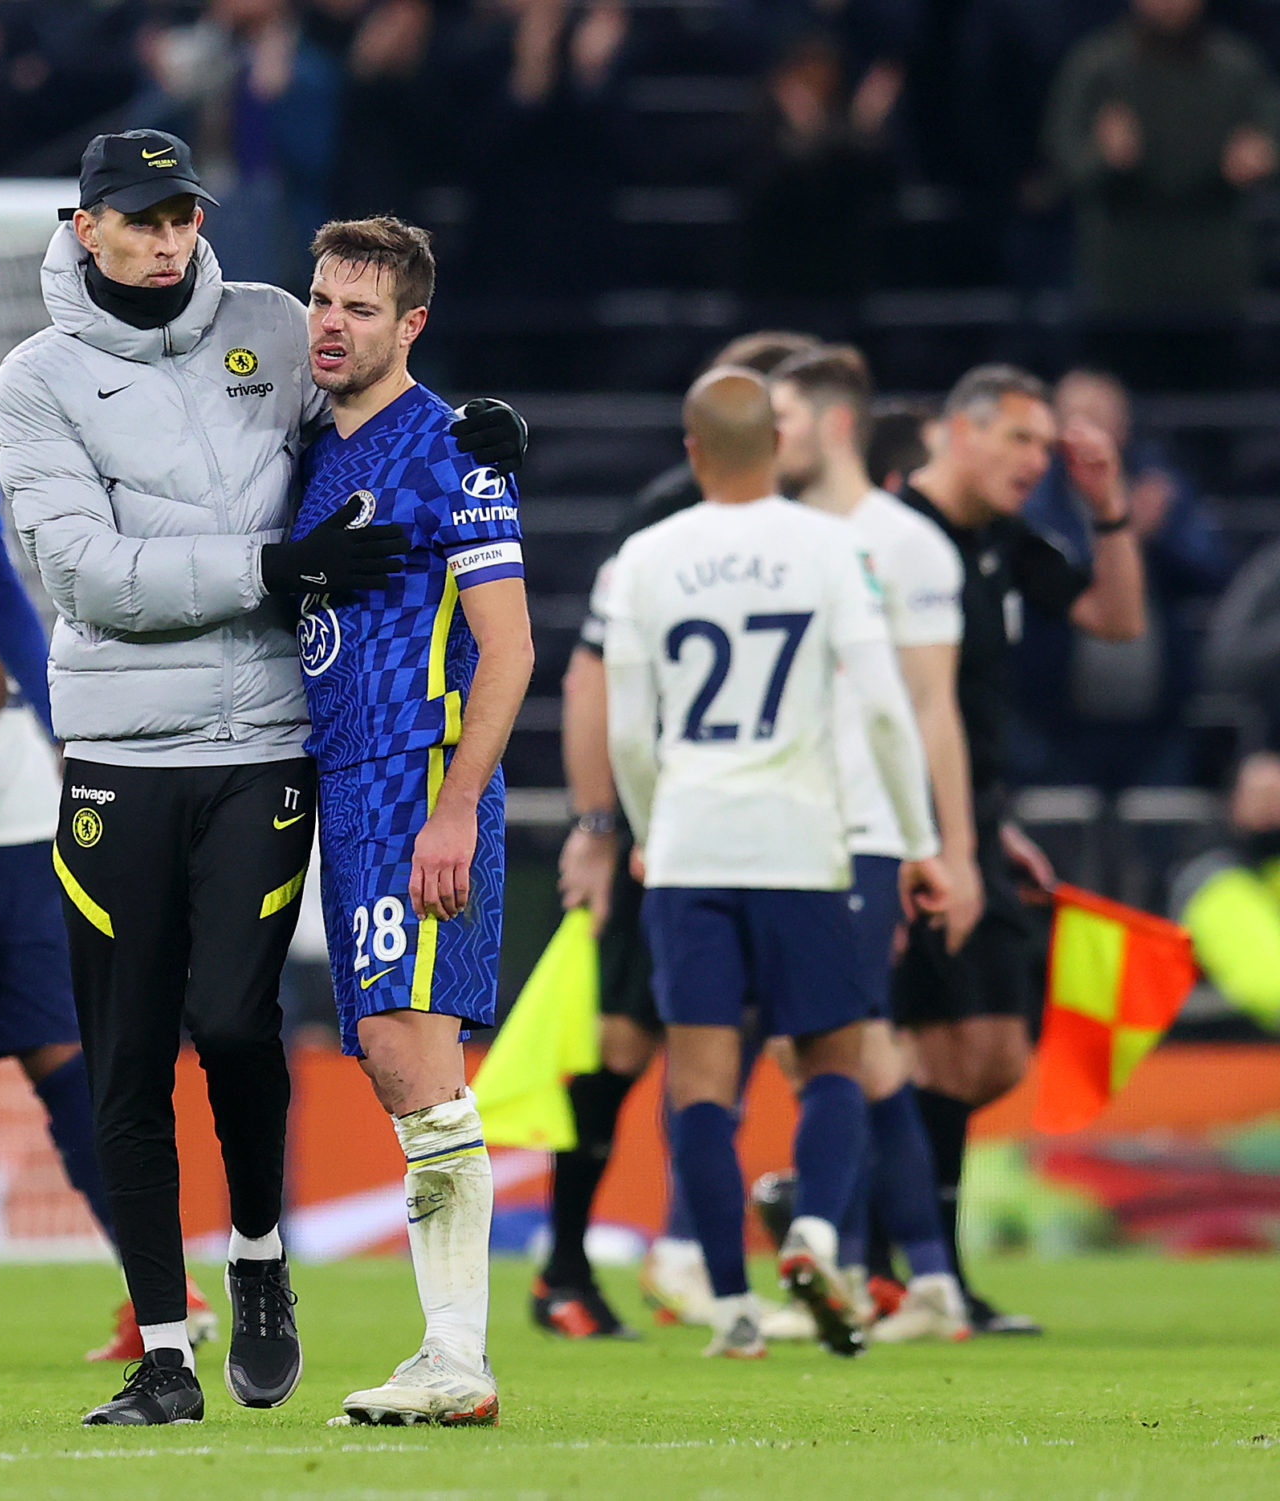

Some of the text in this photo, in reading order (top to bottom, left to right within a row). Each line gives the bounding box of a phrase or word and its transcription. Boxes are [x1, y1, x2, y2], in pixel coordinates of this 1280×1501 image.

[225, 382, 274, 398] trivago
[462, 549, 503, 567] CAPTAIN
[675, 553, 788, 596] LUCAS
[664, 610, 815, 743] 27
[71, 784, 116, 805] trivago
[284, 786, 300, 810] TT
[353, 895, 408, 973] 28
[406, 1192, 444, 1208] CFC
